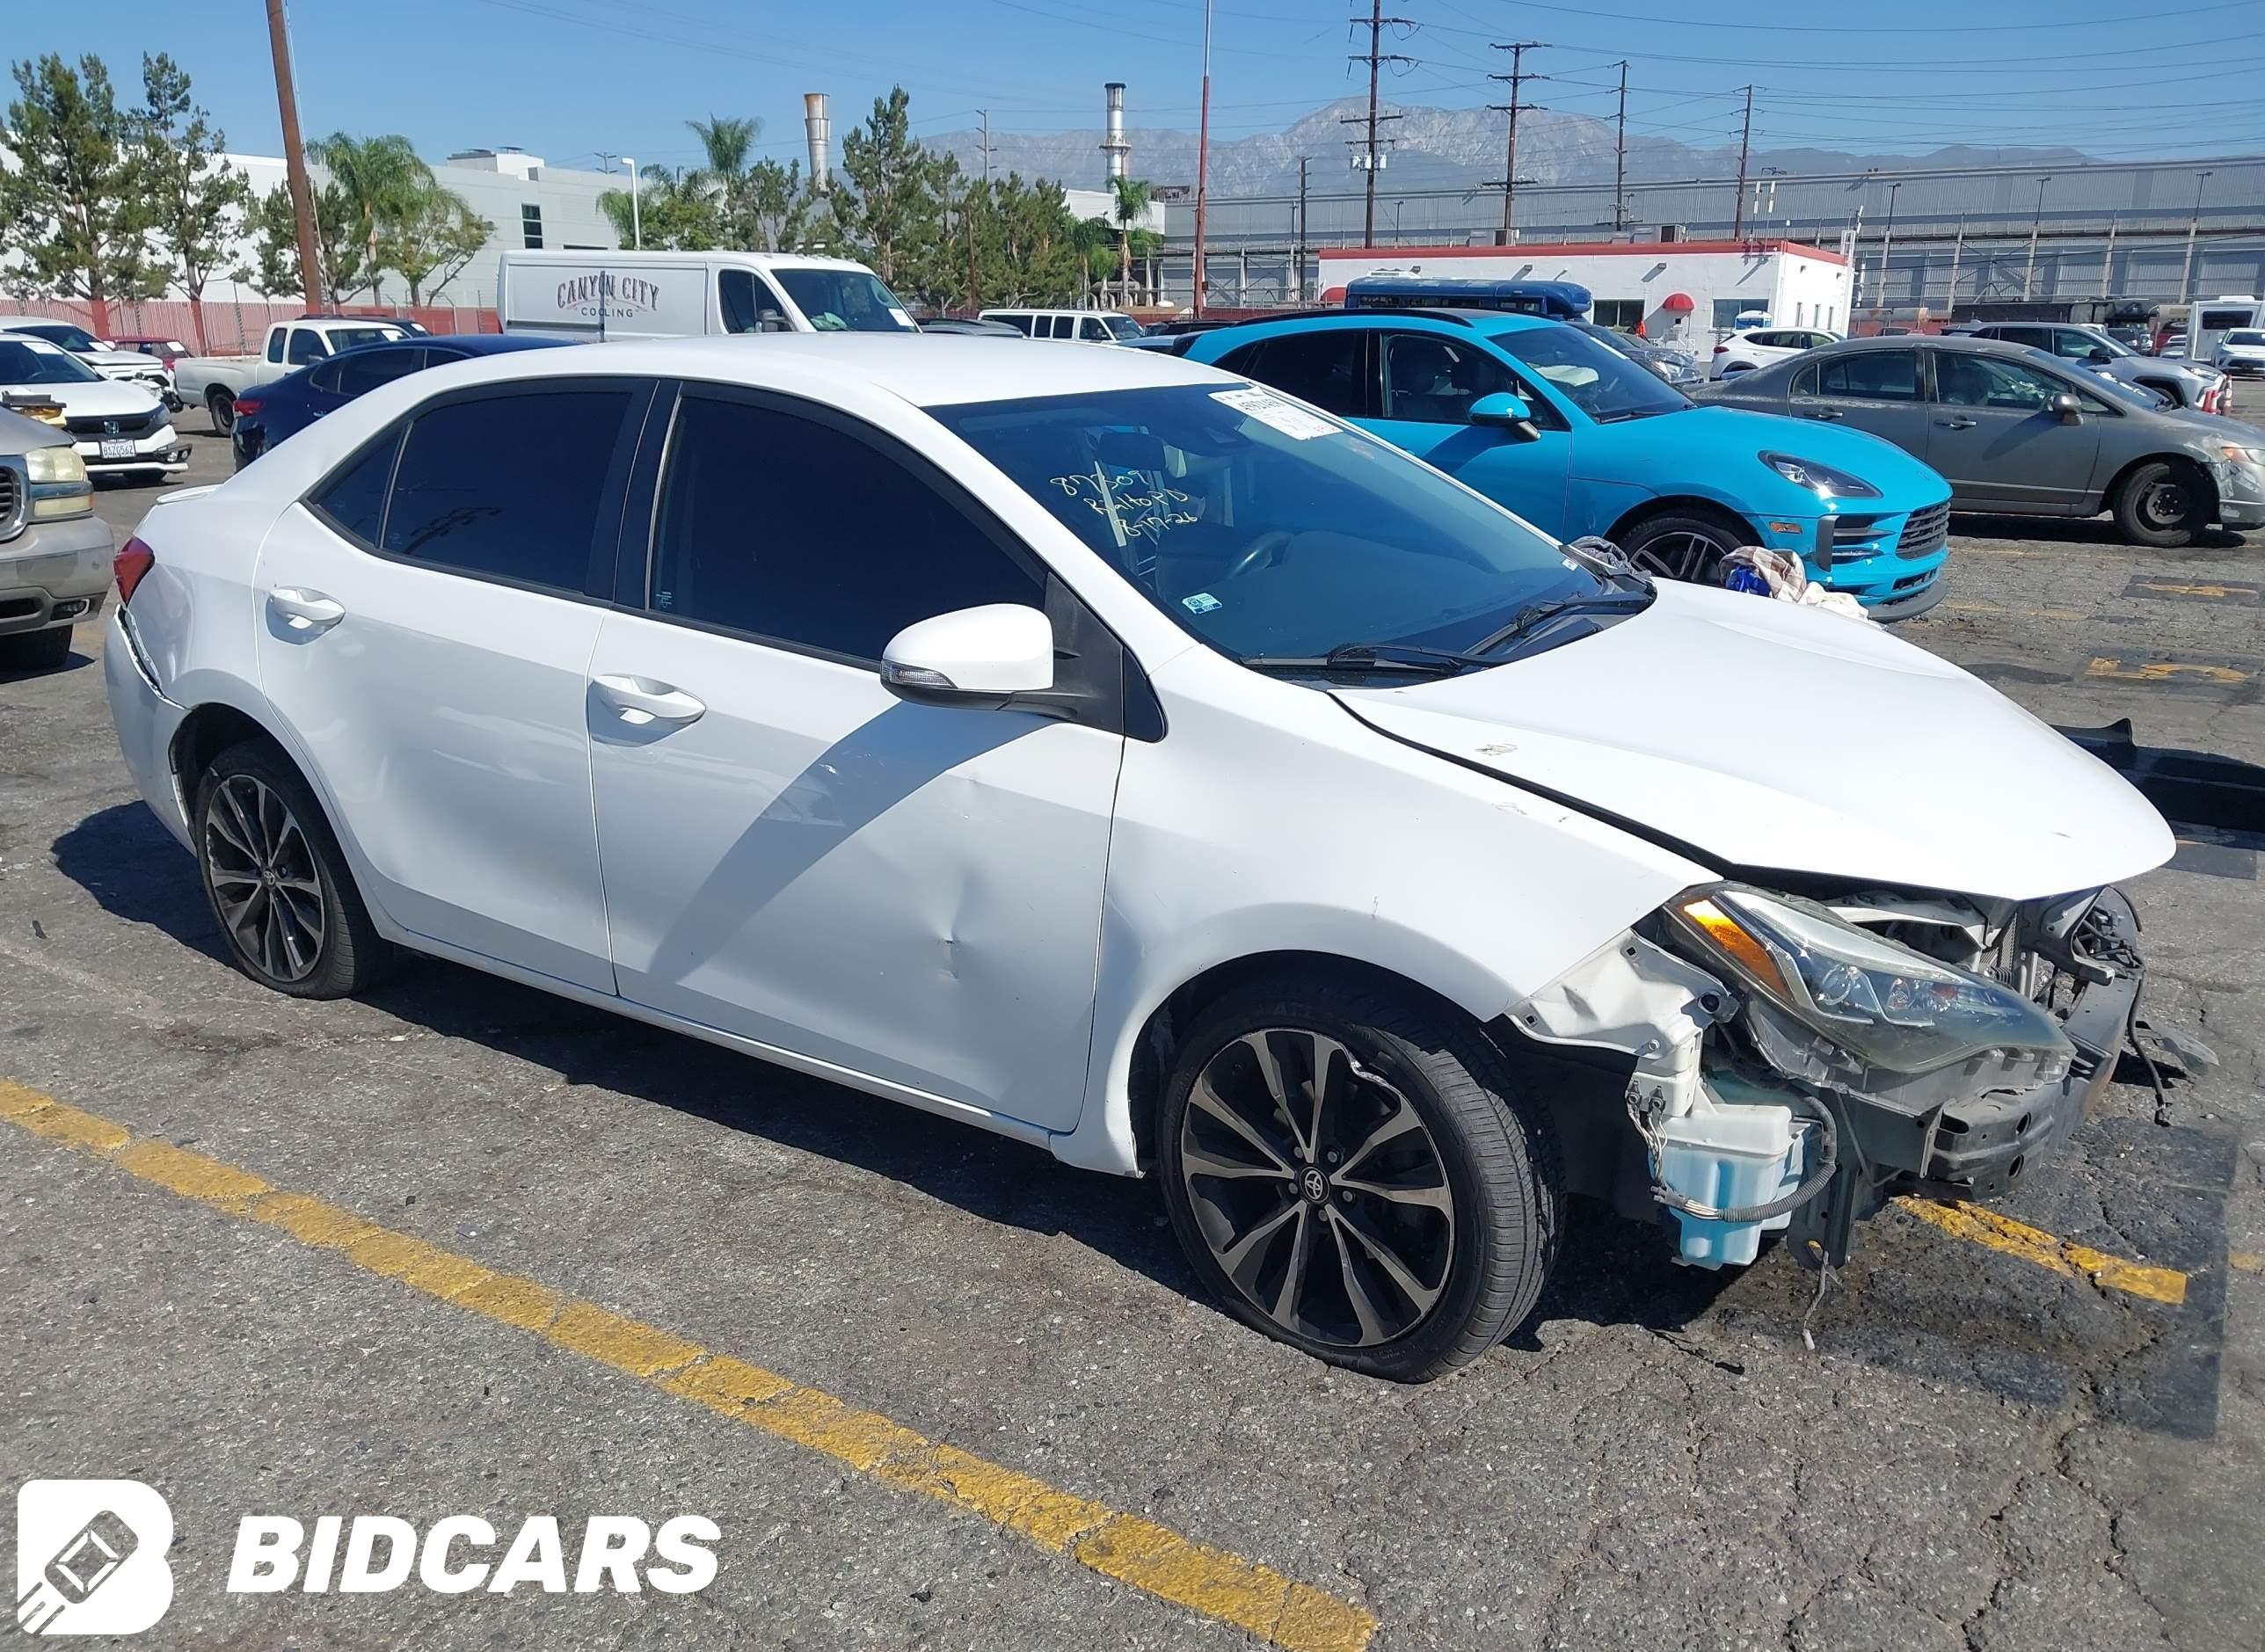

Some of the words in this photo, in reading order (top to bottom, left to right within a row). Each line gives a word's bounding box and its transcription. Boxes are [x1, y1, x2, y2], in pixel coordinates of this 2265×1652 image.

[557, 273, 616, 309] CANYON
[622, 277, 659, 312] CITY
[580, 307, 633, 317] COOLING
